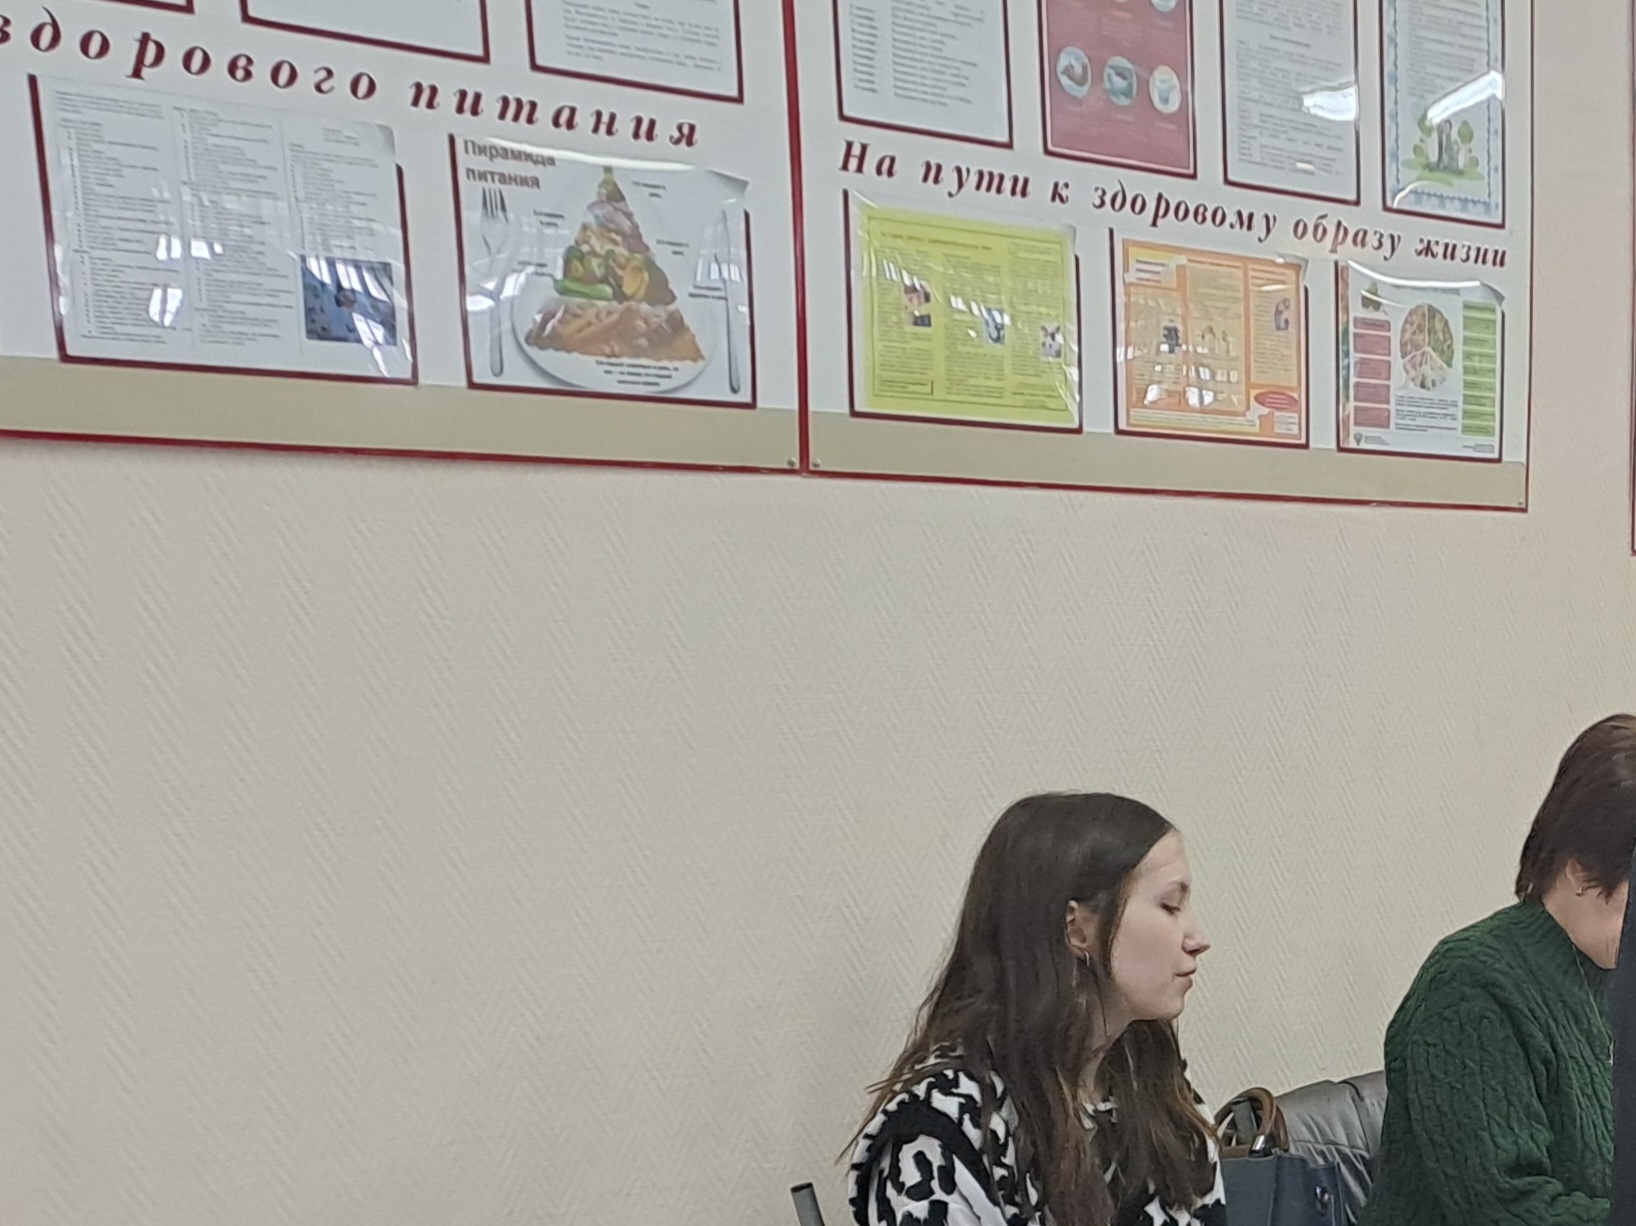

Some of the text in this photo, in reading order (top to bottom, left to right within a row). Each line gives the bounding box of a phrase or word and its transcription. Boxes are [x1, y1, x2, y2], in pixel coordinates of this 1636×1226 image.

[409, 81, 698, 148] питания
[463, 139, 557, 167] Пирамида
[465, 167, 541, 190] питания
[838, 139, 1507, 268] На пути к здоровому образу жизни
